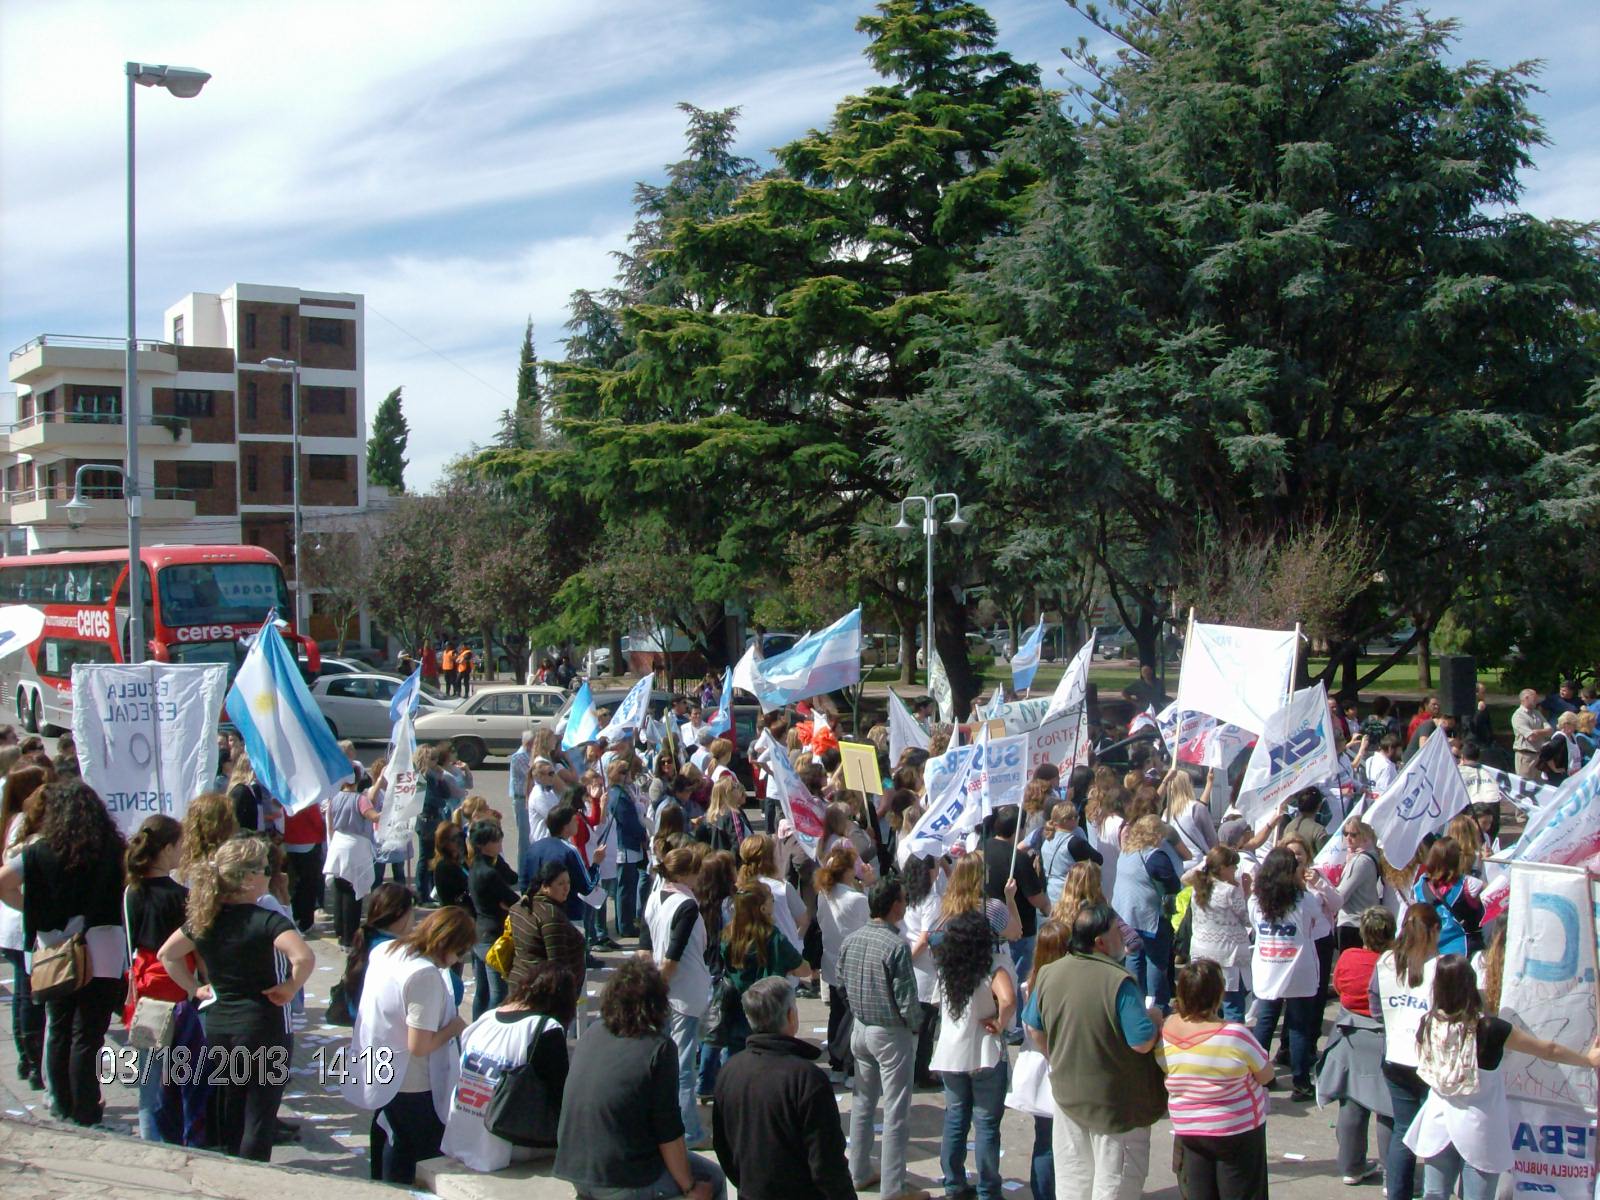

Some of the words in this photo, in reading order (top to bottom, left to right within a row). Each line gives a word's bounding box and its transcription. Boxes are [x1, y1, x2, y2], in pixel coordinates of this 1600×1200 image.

[77, 609, 110, 638] ceres
[176, 624, 234, 642] ceres
[1033, 752, 1050, 766] EN
[1389, 993, 1429, 1012] CERA
